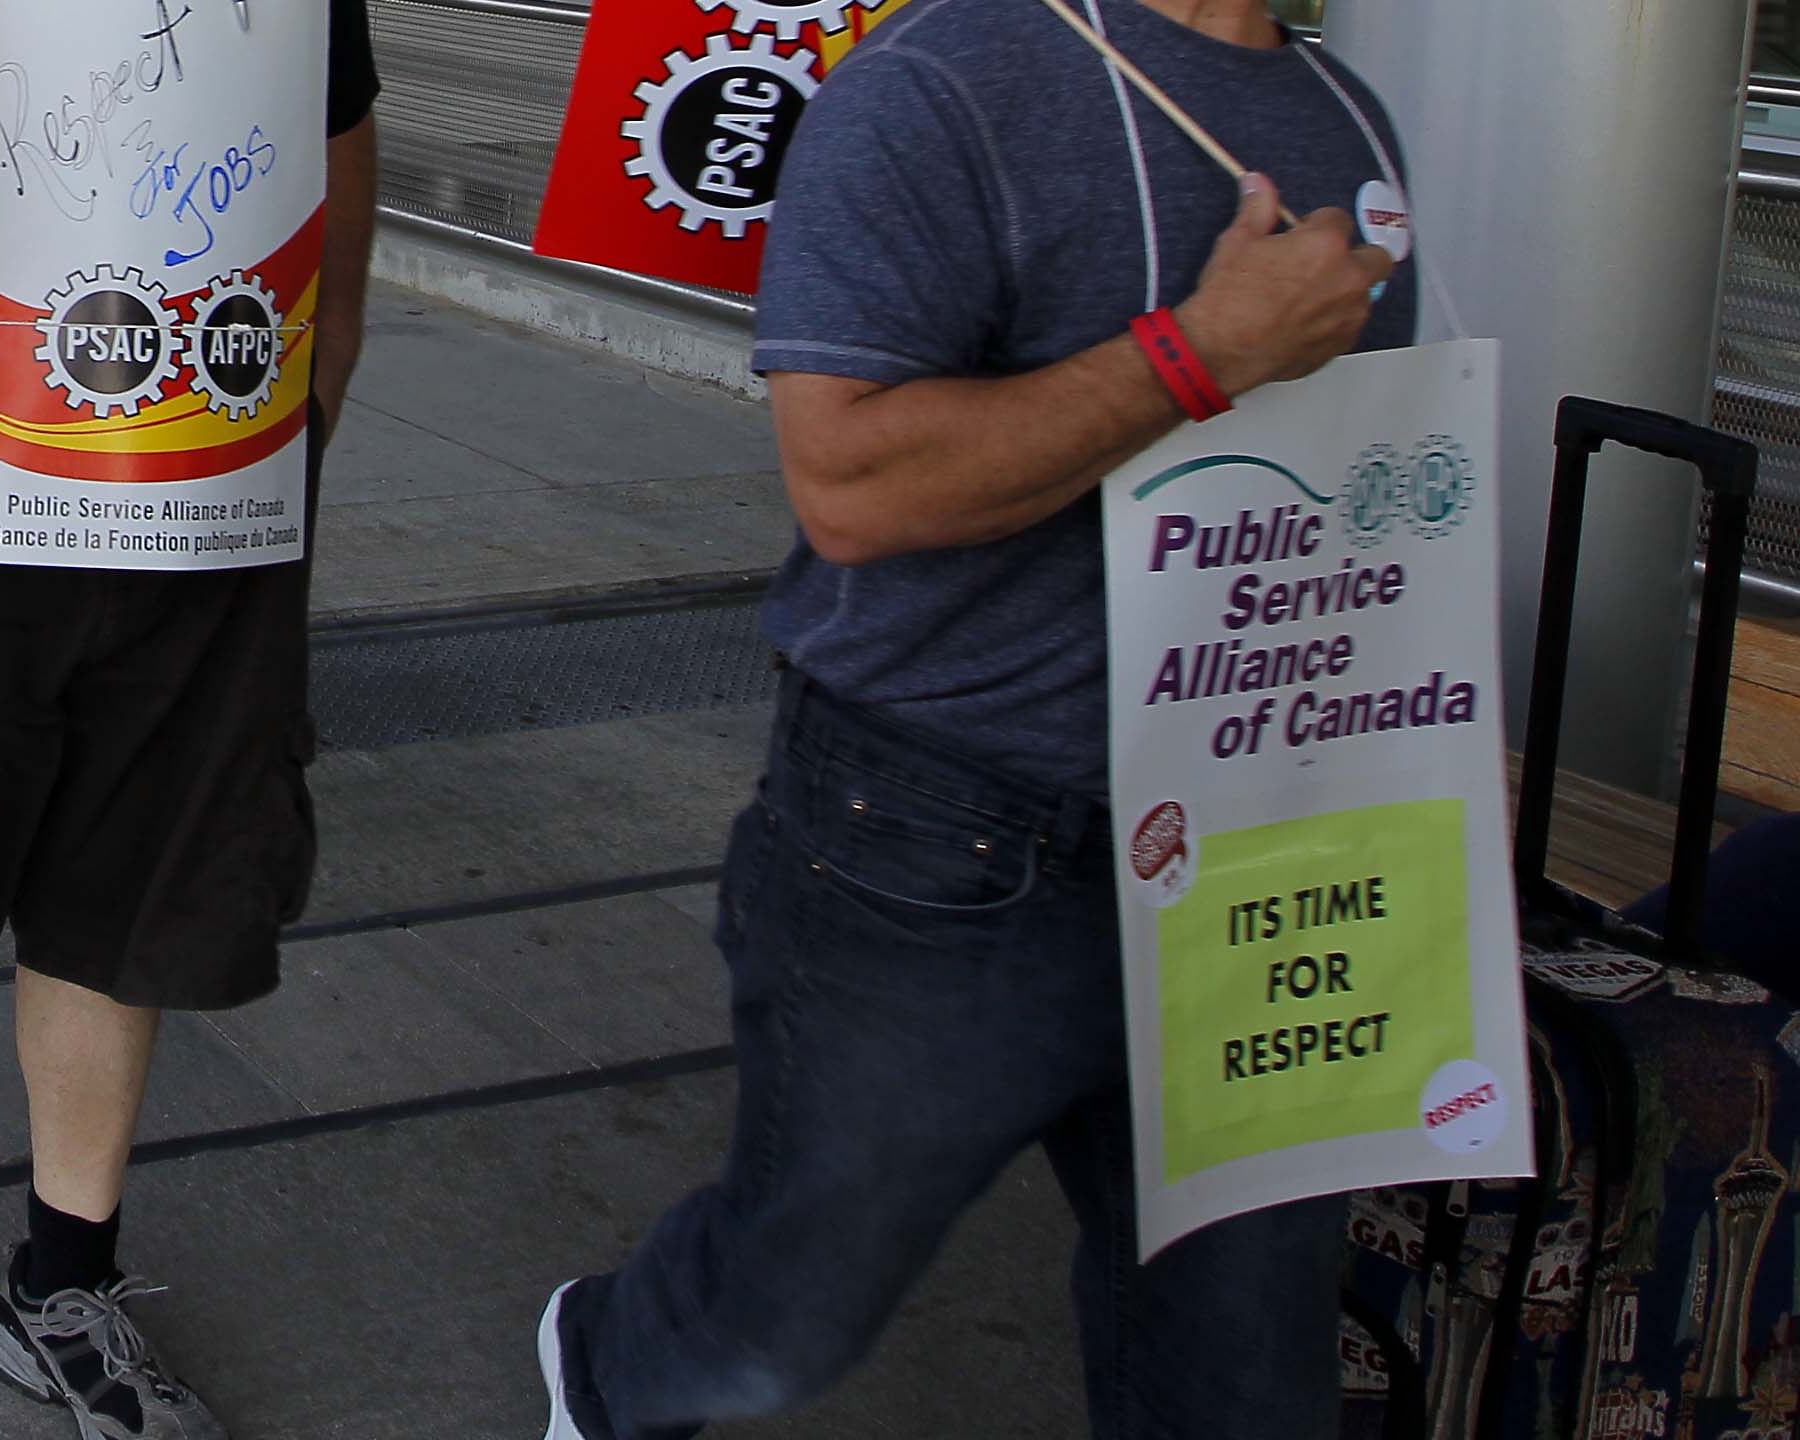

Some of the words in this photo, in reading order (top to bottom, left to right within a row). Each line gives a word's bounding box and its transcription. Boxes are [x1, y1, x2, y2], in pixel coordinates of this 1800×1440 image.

[696, 77, 782, 198] PSAC
[66, 326, 154, 362] PSAC
[208, 328, 269, 364] AFPC
[8, 494, 70, 518] Public
[79, 497, 154, 520] Service
[161, 500, 227, 522] Alliance
[230, 498, 244, 519] of
[247, 496, 285, 518] Canada
[55, 527, 77, 549] de
[84, 529, 100, 550] la
[109, 529, 189, 552] Fonction
[194, 530, 247, 556] publique
[250, 528, 264, 548] du
[266, 524, 298, 547] Canada
[1148, 504, 1325, 572] Public
[1222, 558, 1406, 629] Service
[1144, 634, 1355, 706] Alliance
[1211, 697, 1276, 759] of
[1284, 670, 1477, 748] Canada
[1228, 895, 1283, 946] ITS
[1294, 876, 1387, 930] TIME
[1266, 951, 1353, 1003] FOR
[1223, 1012, 1390, 1082] RESPECT
[1423, 1082, 1498, 1130] RESPECT
